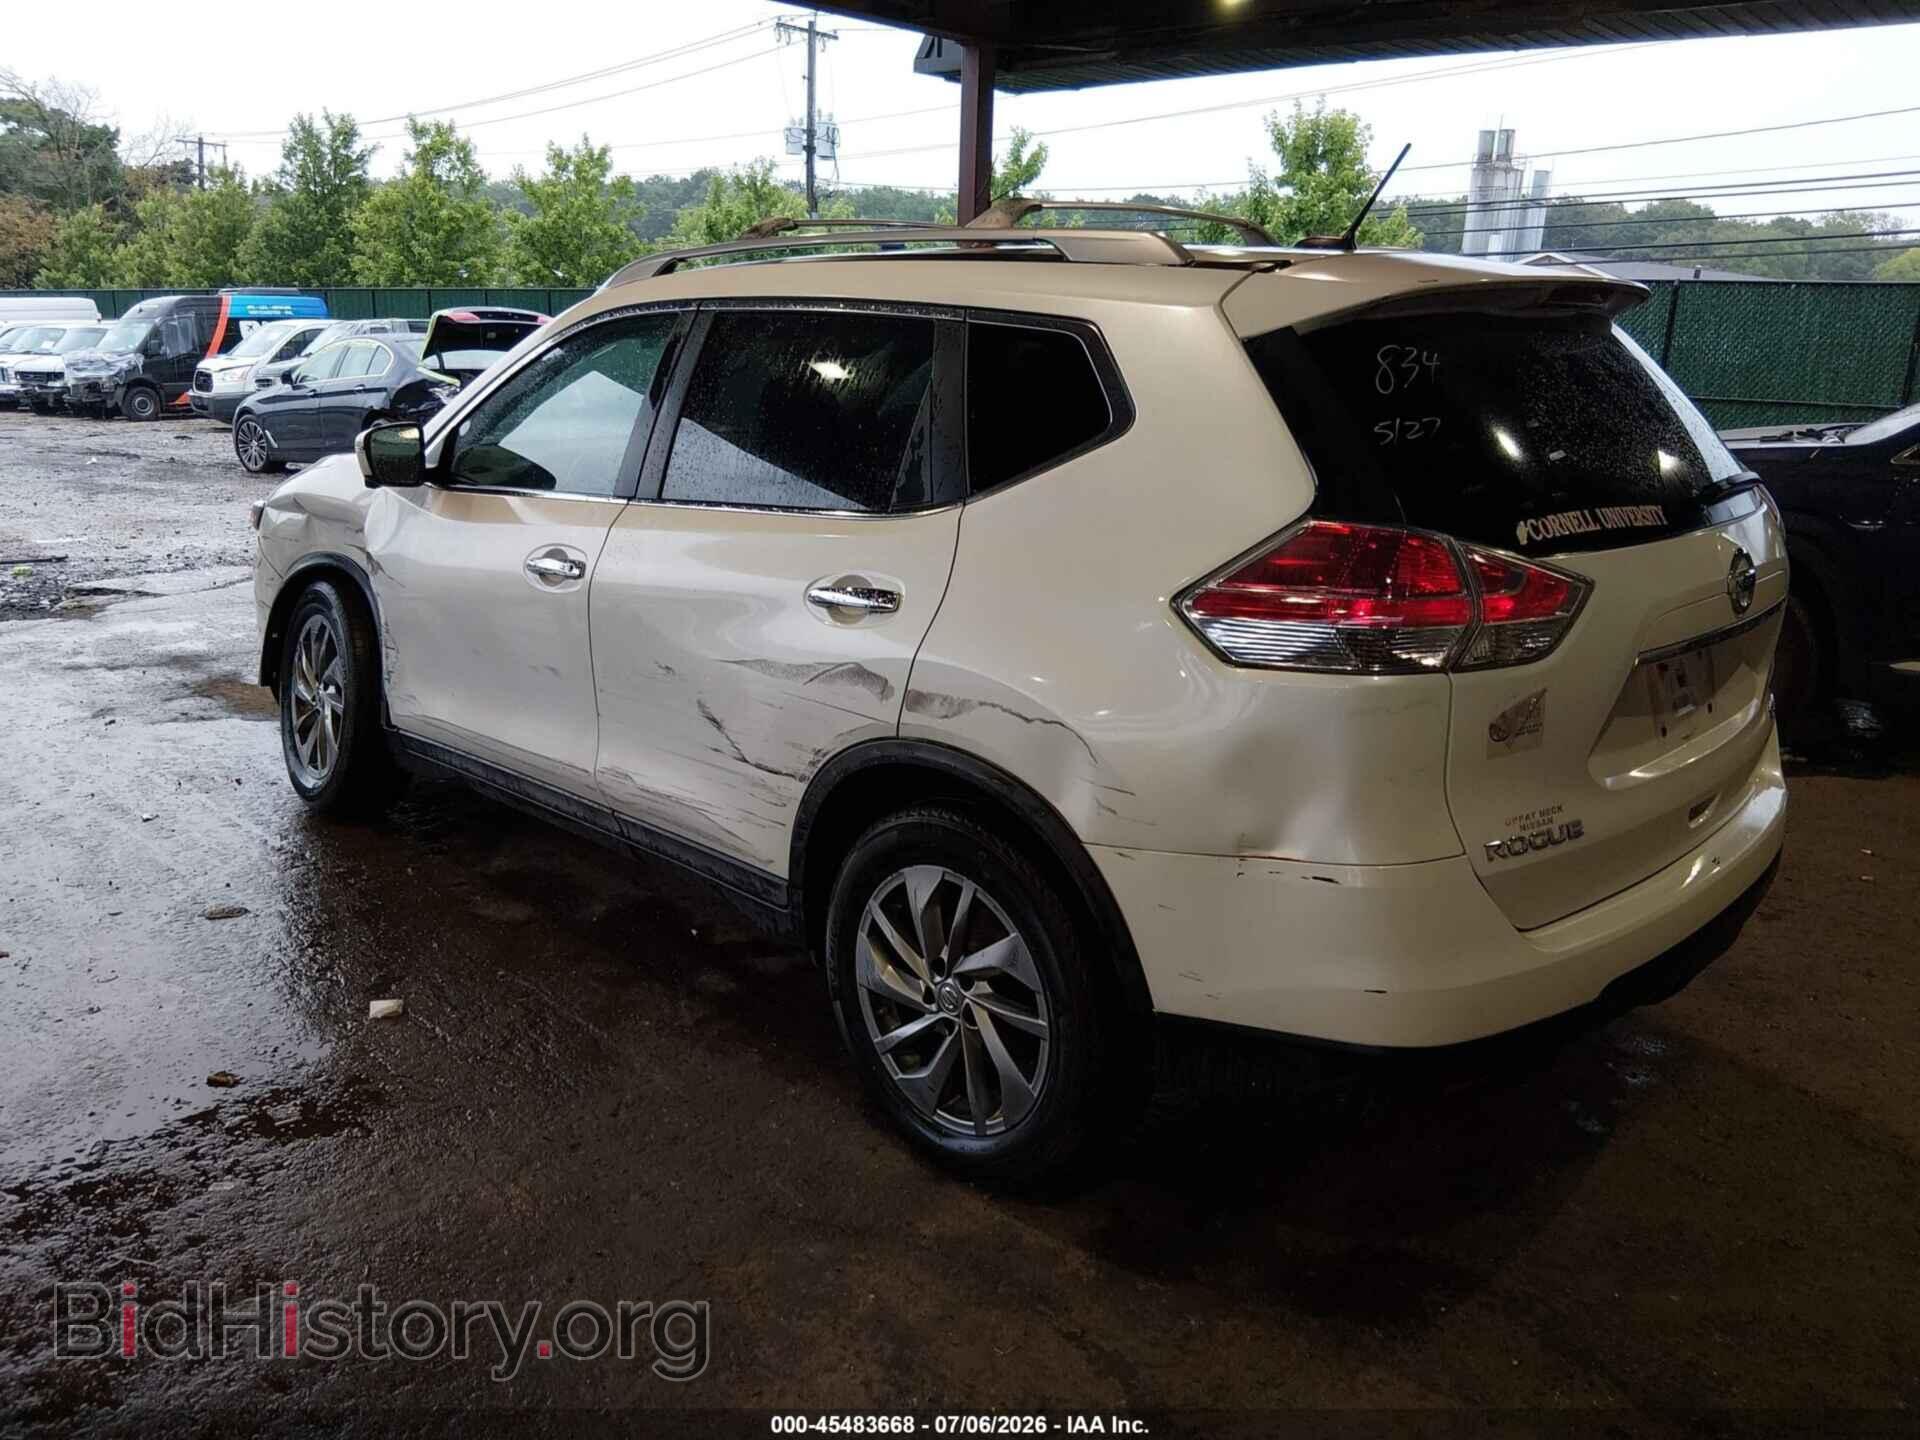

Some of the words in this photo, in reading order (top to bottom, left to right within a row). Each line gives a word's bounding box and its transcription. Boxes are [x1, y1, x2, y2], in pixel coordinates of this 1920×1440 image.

[1375, 344, 1441, 394] 834
[1526, 509, 1601, 541] CORNELL
[1595, 504, 1669, 529] UNIVERSITY
[1483, 818, 1585, 862] ROGUE
